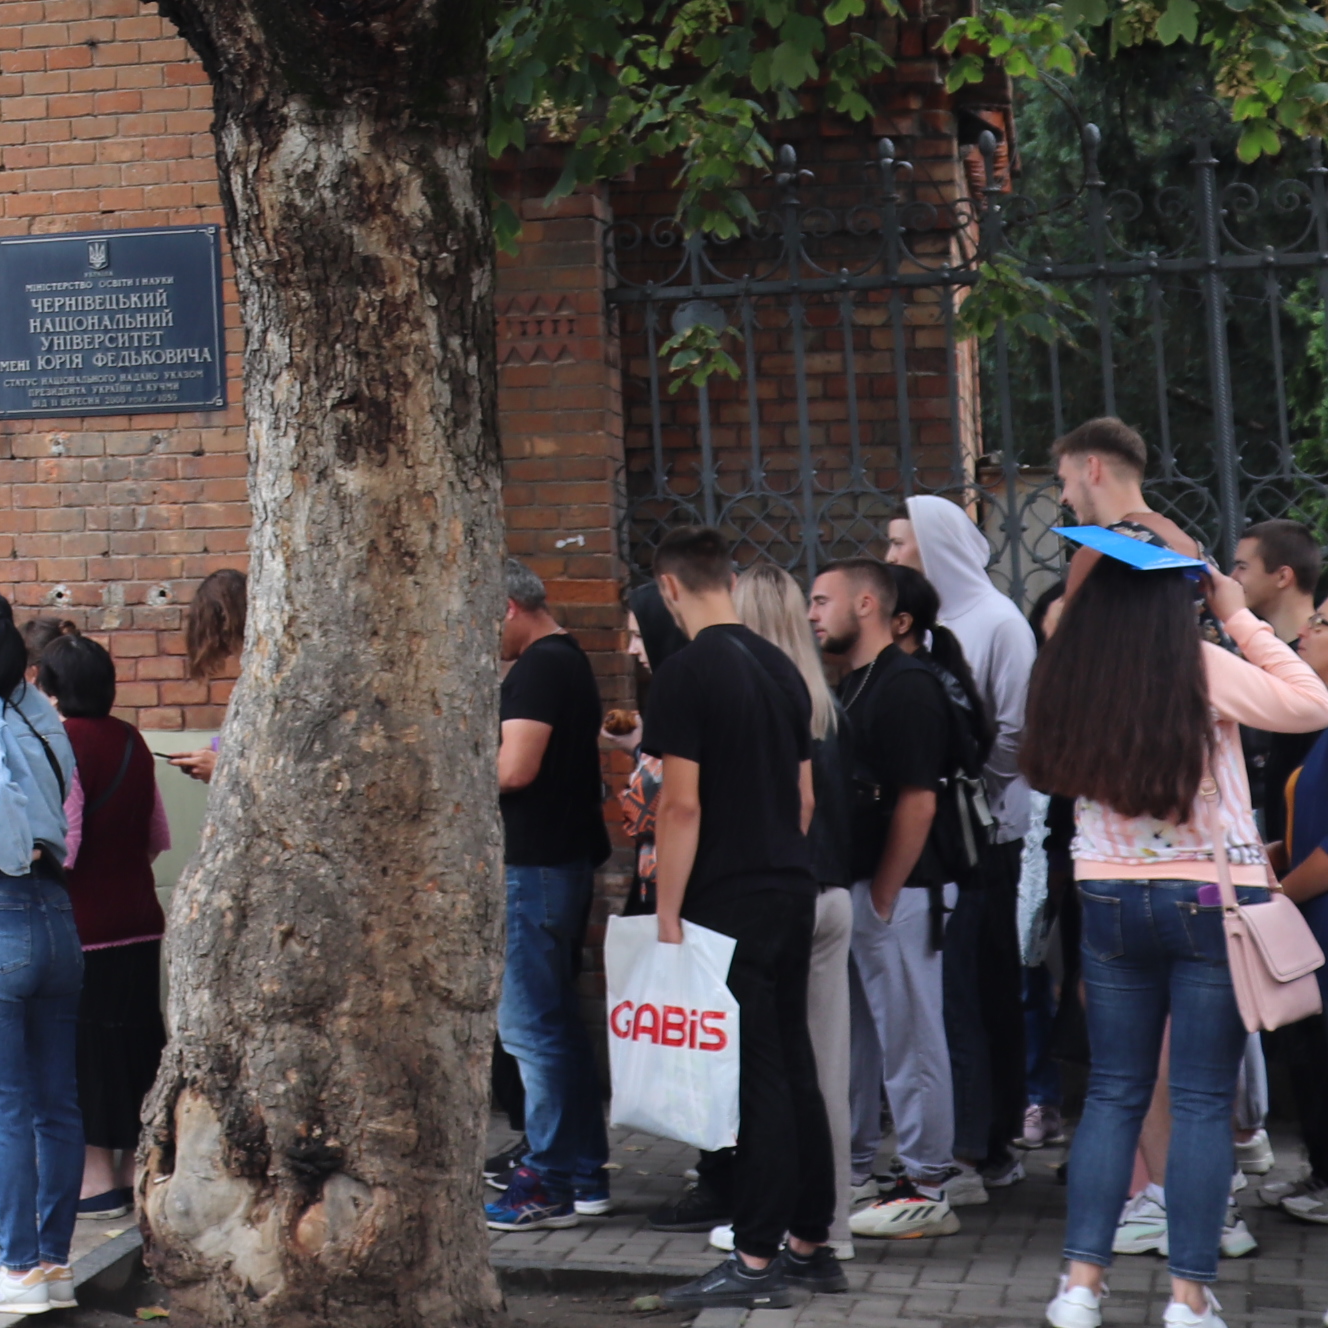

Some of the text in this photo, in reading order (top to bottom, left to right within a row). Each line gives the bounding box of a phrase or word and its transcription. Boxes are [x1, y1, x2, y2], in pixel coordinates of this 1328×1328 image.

[25, 281, 93, 292] МІНІСТЕРСТВО
[98, 278, 134, 288] ОСВІТИ
[141, 276, 174, 286] НАУКИ
[31, 289, 168, 313] ЧЕРНІВЕЦЬКИЙ
[29, 309, 174, 334] НАЦІОНАЛЬНИЙ
[40, 330, 164, 352] УНІВЕРСИТЕТ
[37, 354, 83, 371] ЮРІЯ
[92, 347, 213, 369] ФЕДЬКОВИЧА
[3, 370, 204, 387] СТАТУС НАЦІОНАЛЬНОГО НАДАНО УКАЗОМ
[28, 387, 86, 397] ПРЕЗИДЕНТА
[91, 382, 132, 394] УКРАЇНИ
[32, 399, 47, 408] ВІД
[60, 396, 100, 406] ВЕРЕСНЯ
